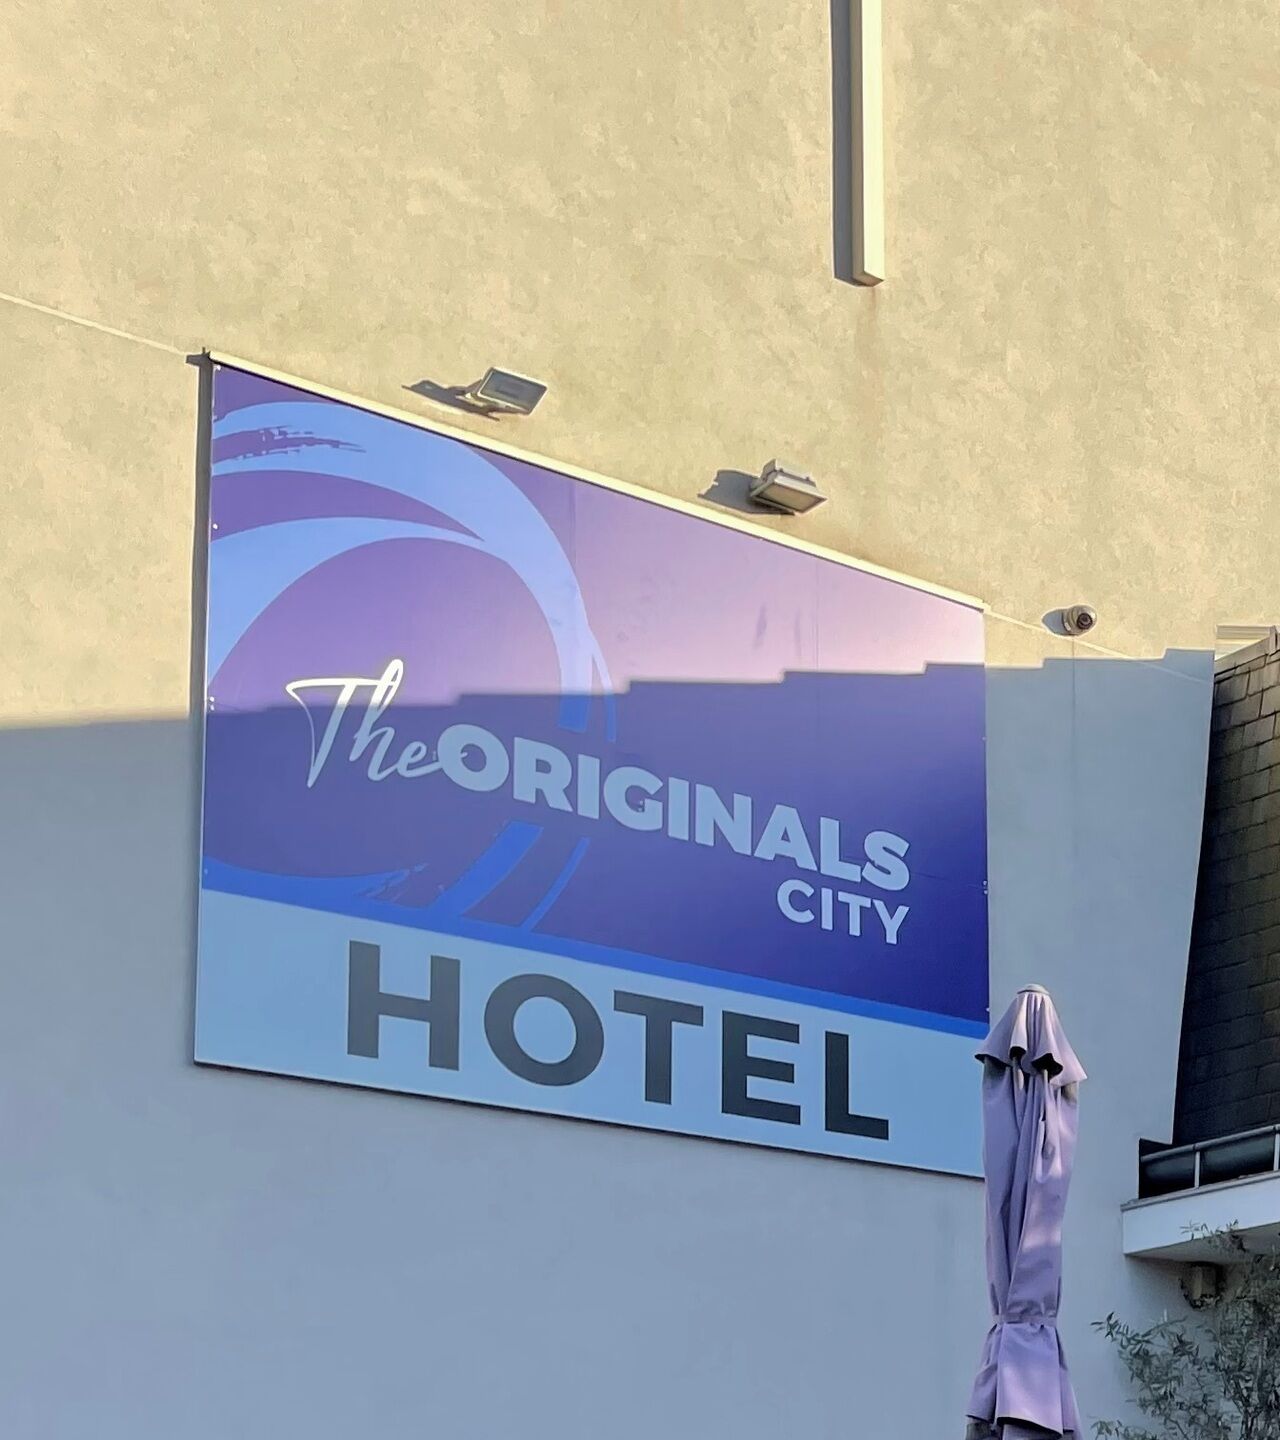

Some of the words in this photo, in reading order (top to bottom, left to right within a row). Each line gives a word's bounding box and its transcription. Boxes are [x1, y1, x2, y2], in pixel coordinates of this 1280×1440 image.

[285, 658, 443, 788] The
[436, 723, 913, 891] ORIGINALS
[776, 878, 910, 945] CITY
[346, 939, 890, 1141] HOTEL
